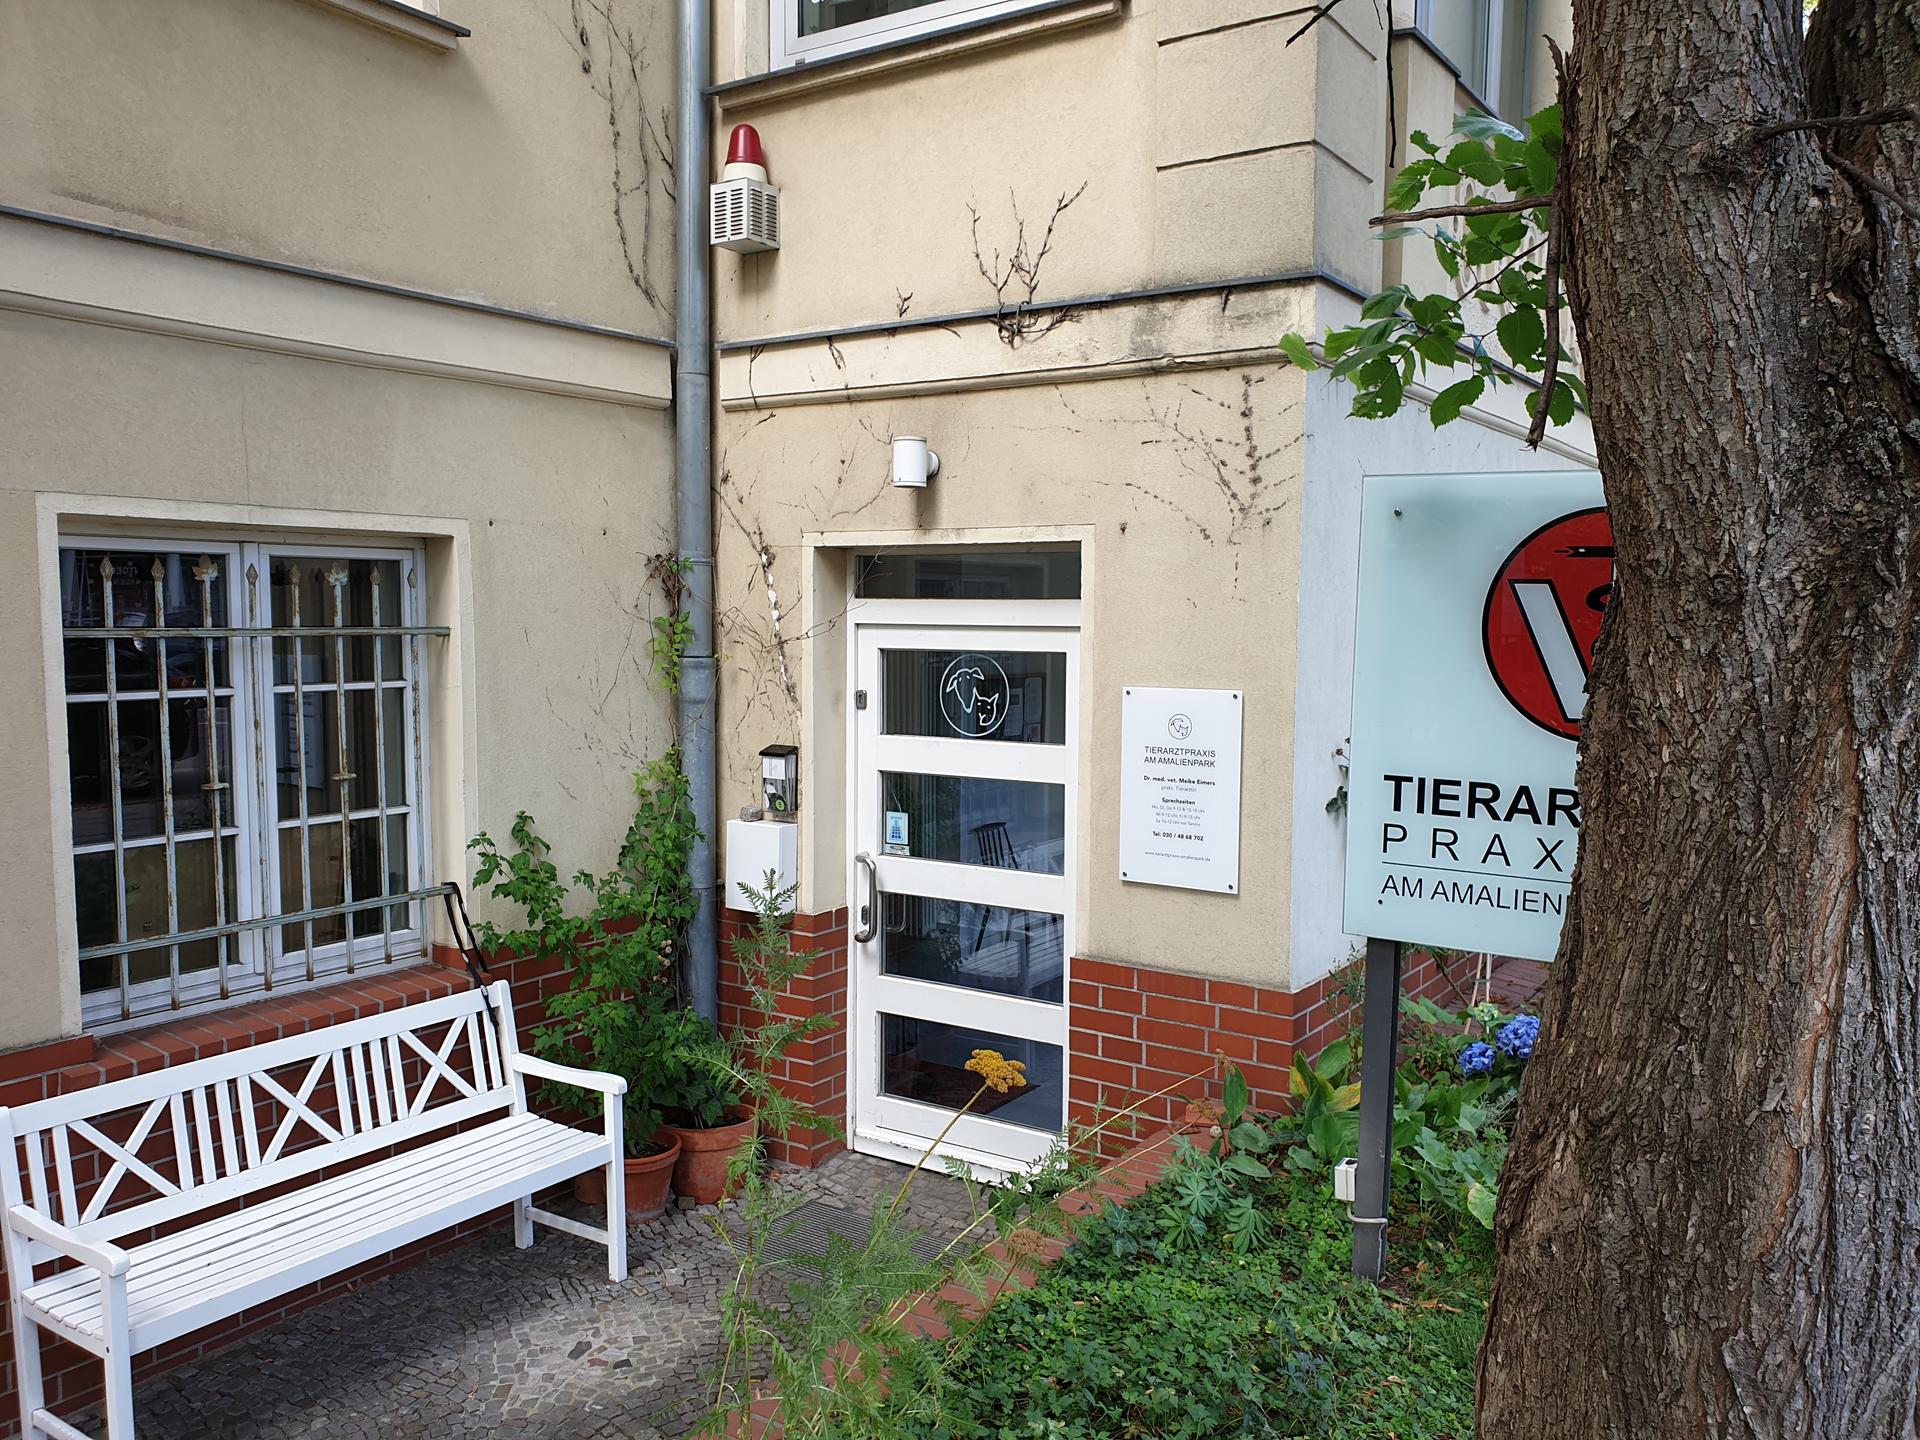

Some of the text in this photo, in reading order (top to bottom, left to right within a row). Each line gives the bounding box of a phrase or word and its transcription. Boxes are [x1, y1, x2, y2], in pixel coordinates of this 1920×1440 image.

[1144, 746, 1216, 758] TIERARZTPRAXIS
[1144, 756, 1216, 768] AM AMALIENPARK
[1161, 797, 1196, 805] Sprechzeiten
[1381, 875, 1570, 916] AM AMALIEN
